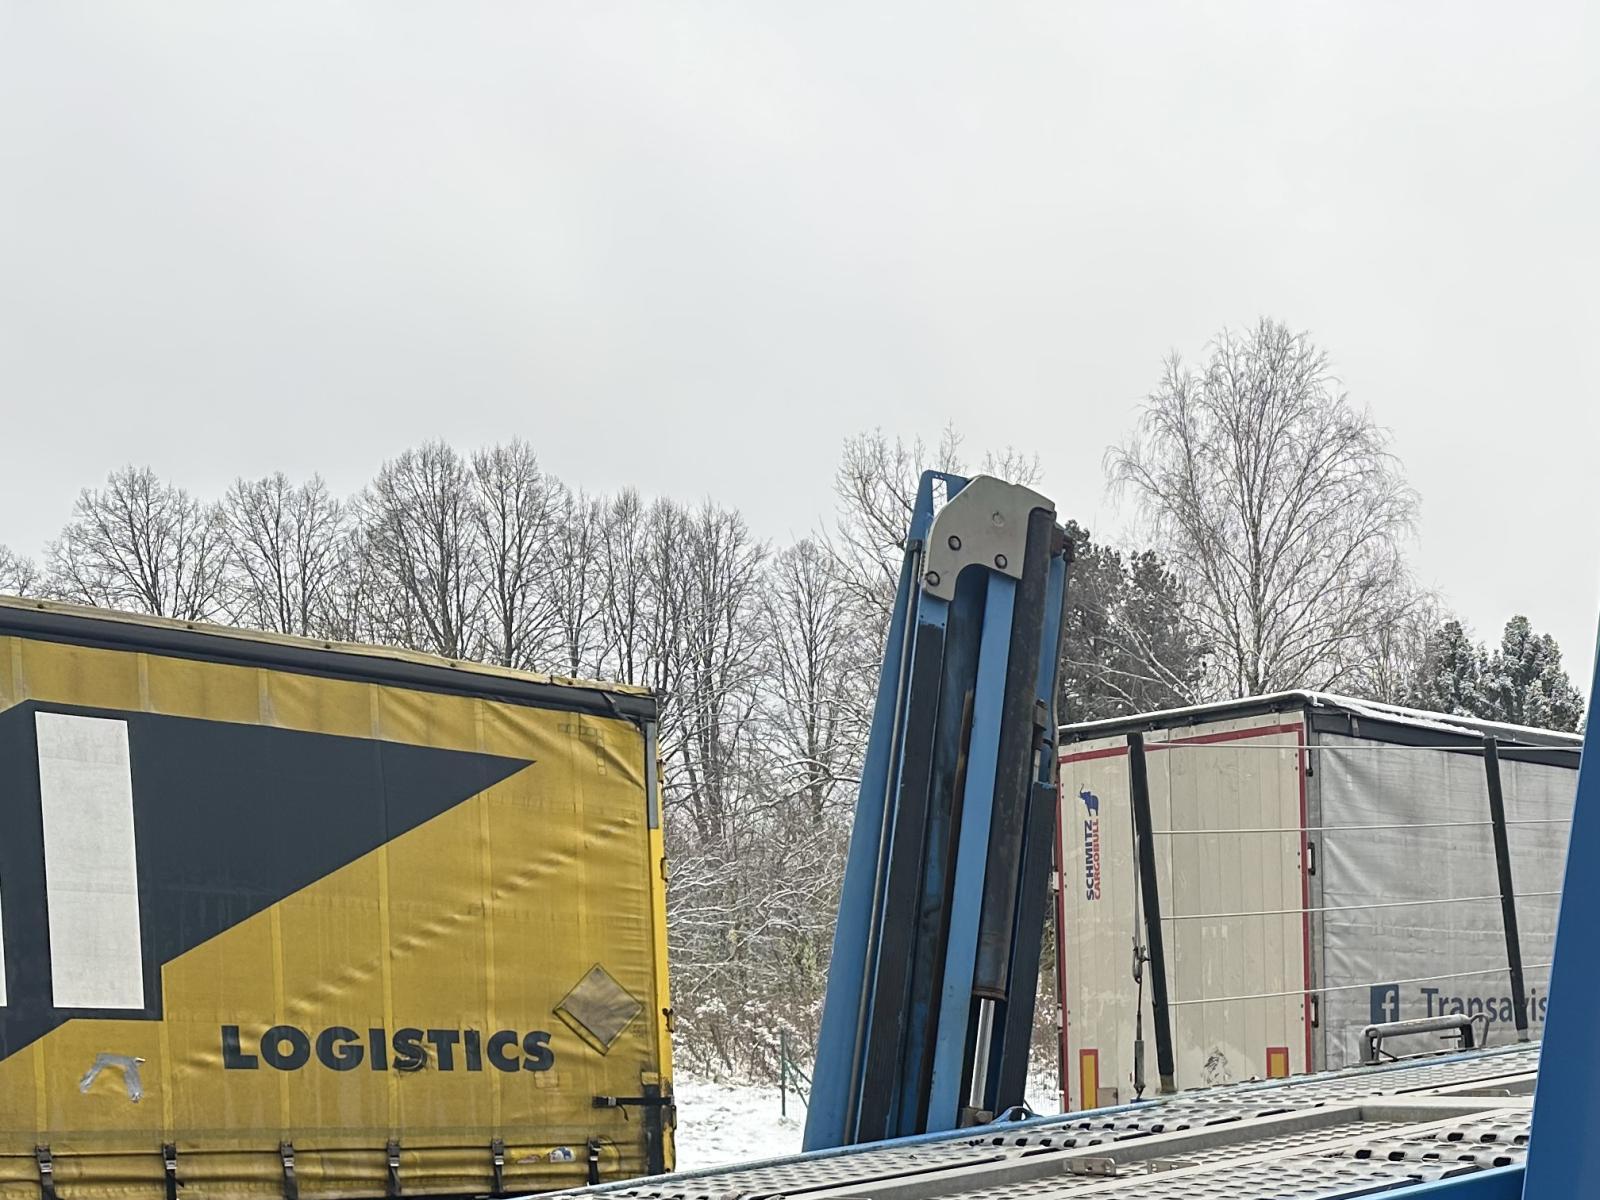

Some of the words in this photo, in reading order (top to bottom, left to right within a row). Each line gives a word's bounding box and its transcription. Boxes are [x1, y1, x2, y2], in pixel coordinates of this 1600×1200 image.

[1084, 819, 1094, 901] SCHMITZ
[1092, 818, 1101, 900] CARGOBULL
[221, 1025, 555, 1072] LOGISTICS
